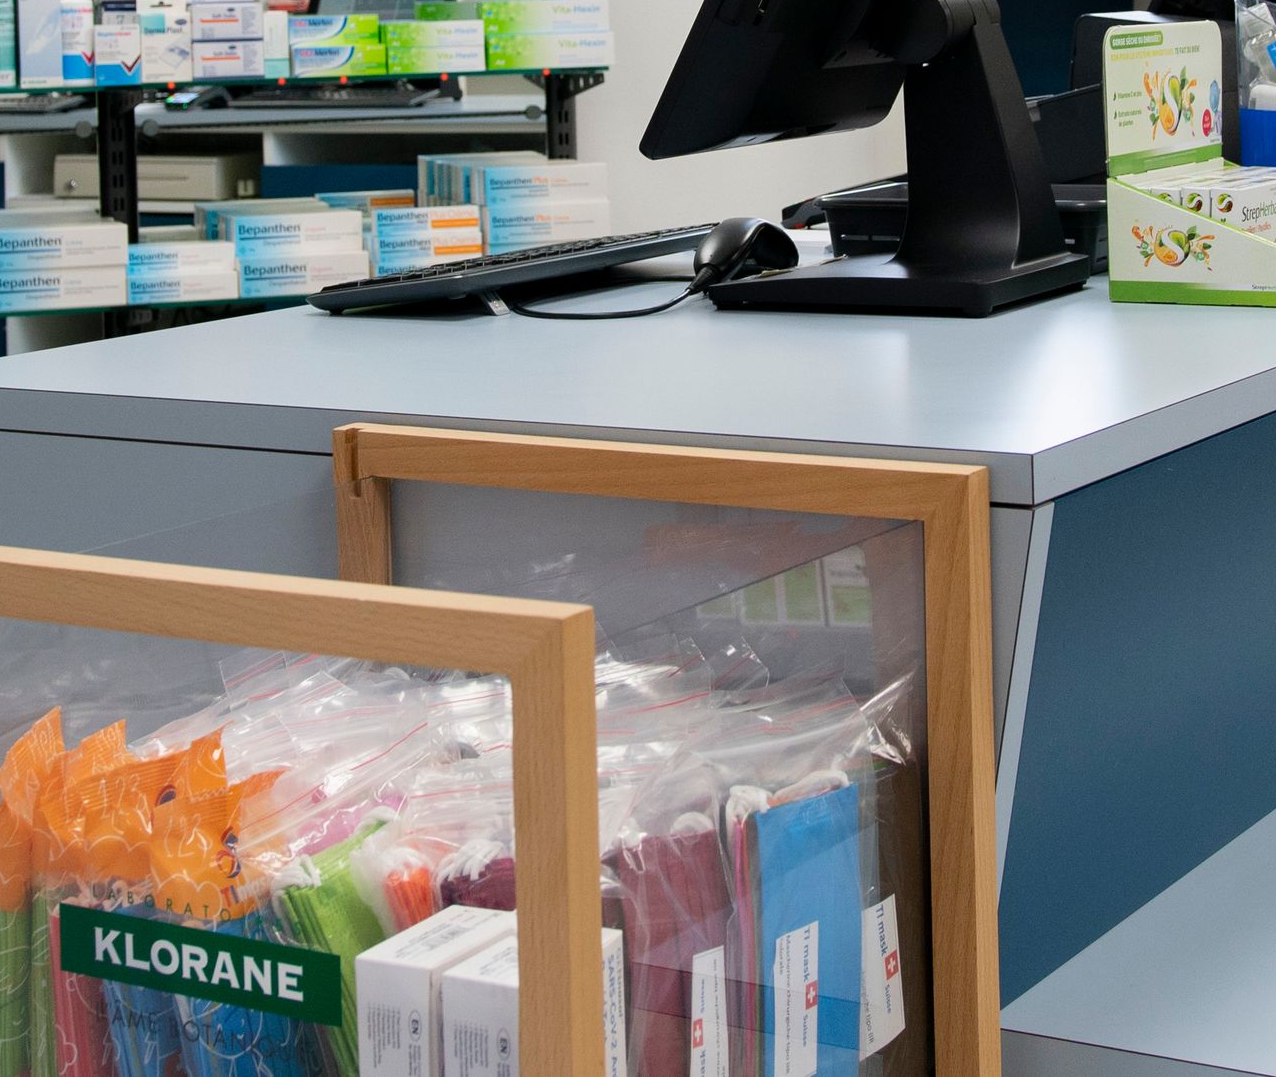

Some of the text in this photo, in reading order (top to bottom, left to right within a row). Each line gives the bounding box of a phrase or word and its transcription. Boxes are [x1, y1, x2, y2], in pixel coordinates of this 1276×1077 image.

[490, 176, 532, 186] Bepanthen
[376, 210, 429, 223] Bepanthen
[492, 214, 535, 224] Bepanthen
[237, 222, 302, 237] Bepanthen
[379, 238, 431, 250] Bepanthen
[128, 250, 179, 262] Bepanthen
[243, 263, 307, 277] Bepanthen
[129, 279, 181, 291] Bepanthen
[803, 927, 811, 941] TI
[94, 926, 304, 1003] KLORANE
[875, 904, 892, 1014] TI mask Suisse
[411, 1018, 420, 1036] EN
[865, 1015, 873, 1032] tipo
[499, 1037, 508, 1054] EN
